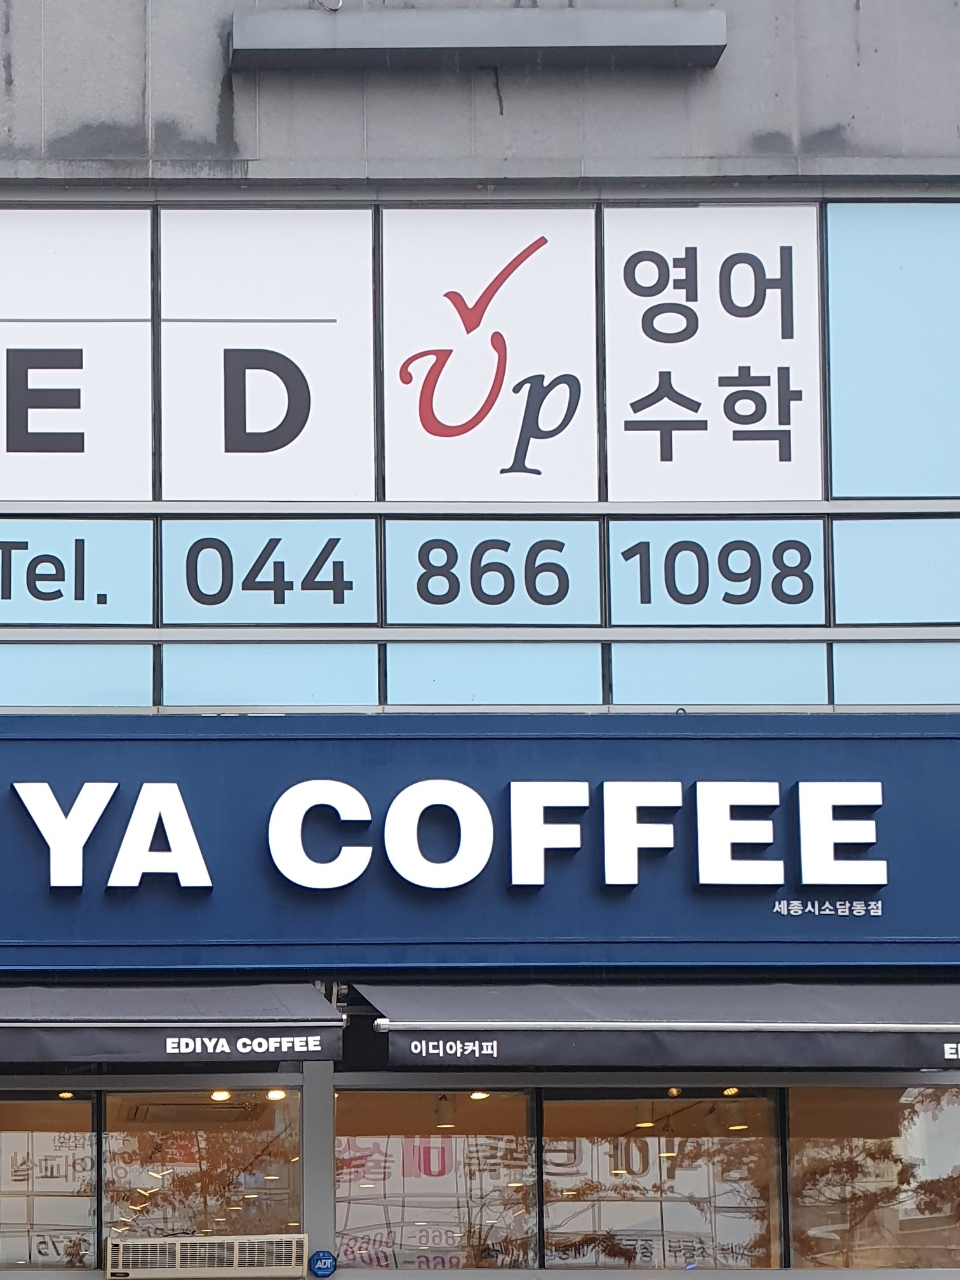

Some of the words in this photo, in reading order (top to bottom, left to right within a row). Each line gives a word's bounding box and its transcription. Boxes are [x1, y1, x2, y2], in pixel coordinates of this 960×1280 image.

[623, 246, 795, 343] 영어
[623, 366, 803, 462] 수학
[185, 537, 353, 605] 044
[417, 538, 570, 605] 866
[621, 541, 814, 605] 1098
[268, 779, 888, 891] COFFEE
[773, 900, 883, 918] 세종시소담동점
[165, 1037, 230, 1055] EDIYA
[236, 1036, 322, 1054] COFFEE
[410, 1040, 498, 1058] 이디야커피
[944, 1043, 960, 1059] E
[315, 1259, 333, 1269] ADT
